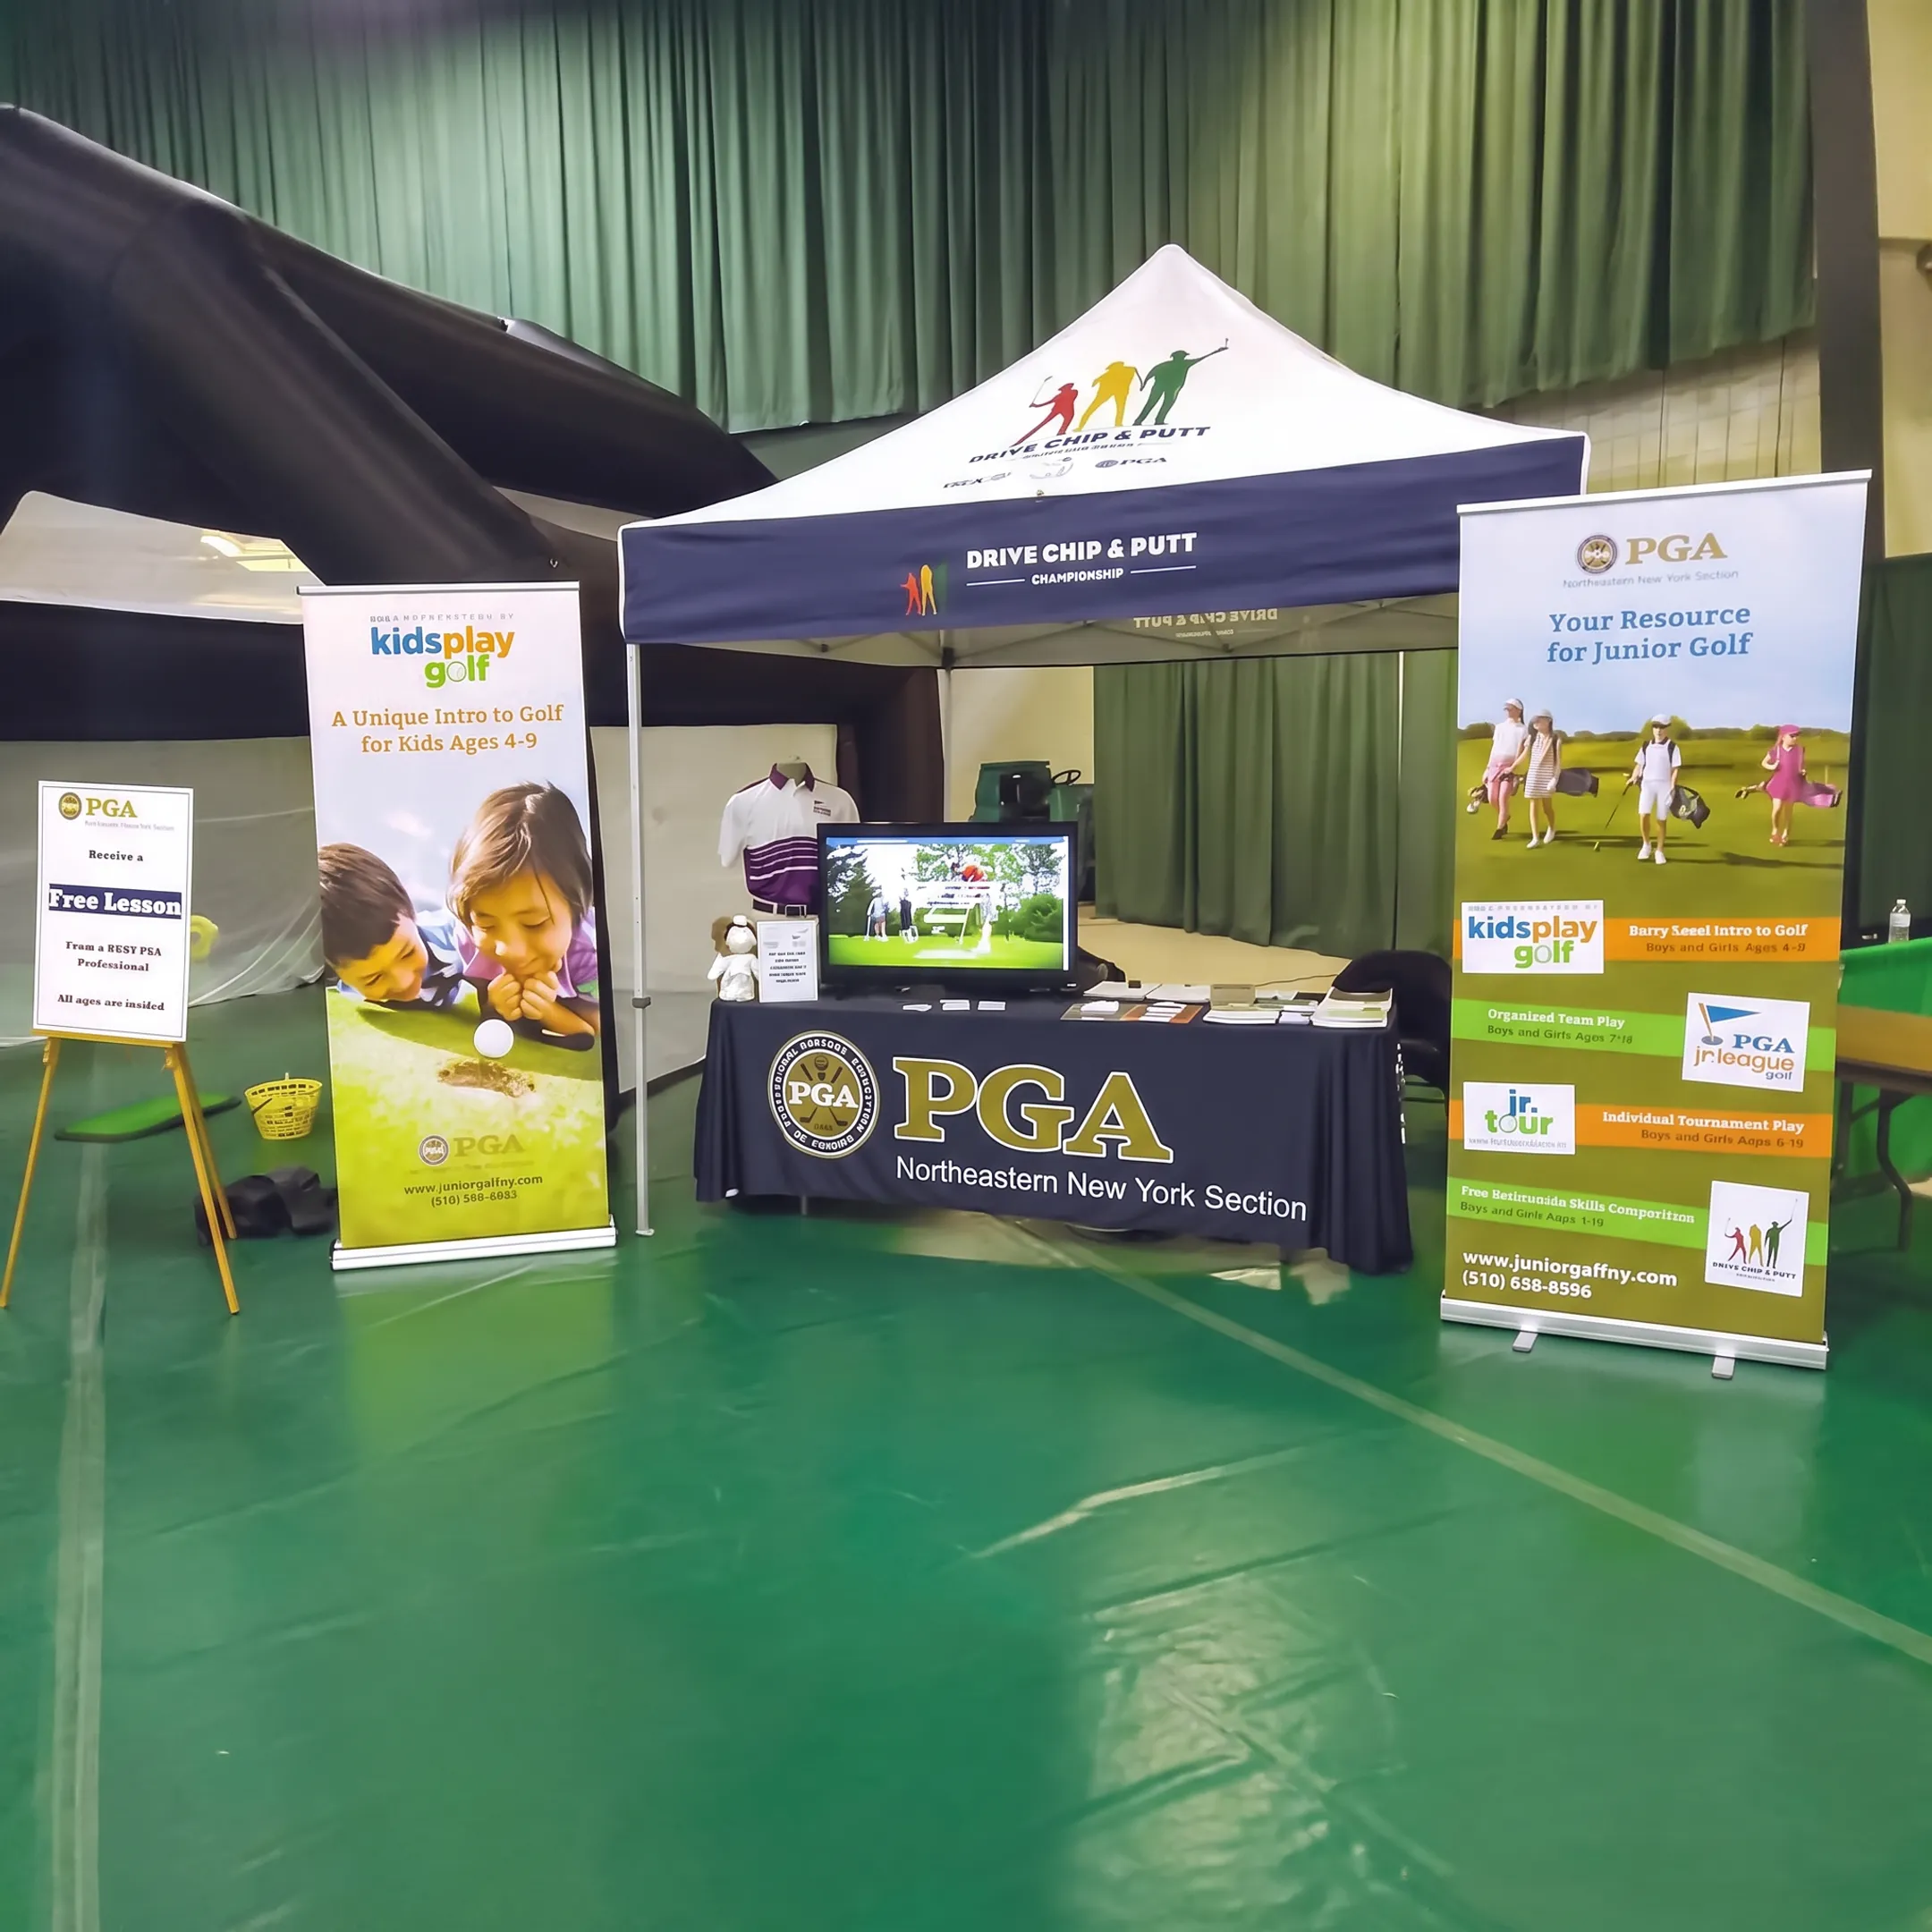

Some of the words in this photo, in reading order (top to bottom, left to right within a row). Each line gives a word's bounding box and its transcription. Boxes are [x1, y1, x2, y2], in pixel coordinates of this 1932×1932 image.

[969, 444, 1038, 463] DRIVE
[1044, 432, 1108, 449] CHIP
[1114, 430, 1131, 441] &
[1139, 427, 1211, 439] PUTT
[1119, 457, 1167, 465] PGA
[966, 545, 1038, 569] DRIVE
[1042, 540, 1102, 564] CHIP
[1106, 538, 1124, 559] &
[1131, 532, 1198, 557] PUTT
[1625, 532, 1728, 565] PGA
[1031, 568, 1123, 585] CHAMPIONSHIP
[1666, 572, 1691, 582] York
[1549, 614, 1614, 632] Your
[1620, 607, 1750, 630] Resource
[370, 625, 515, 659] kidsplay
[1546, 641, 1588, 663] for
[1592, 637, 1682, 665] Junior
[1690, 631, 1753, 657] Golf
[424, 654, 490, 689] golf
[332, 711, 347, 726] A
[352, 709, 428, 731] Unique
[435, 708, 487, 725] Intro
[494, 708, 513, 724] to
[520, 705, 564, 722] Golf
[361, 735, 393, 753] for
[398, 734, 444, 752] Kids
[449, 734, 499, 756] Ages
[504, 733, 538, 750] 4-9
[85, 797, 138, 818] PGA
[89, 850, 133, 861] Receive
[137, 853, 143, 861] a
[49, 888, 98, 911] Free
[104, 892, 182, 916] Lesson
[1468, 915, 1597, 944] kidsplay
[1714, 925, 1752, 936] Intro
[1756, 926, 1771, 936] to
[1775, 924, 1809, 936] Golf
[1513, 939, 1574, 969] golf
[1647, 943, 1675, 953] Boys
[1680, 943, 1704, 953] and
[1708, 943, 1739, 953] Girls
[78, 959, 149, 972] Professional
[57, 995, 73, 1004] All
[76, 997, 101, 1006] ages
[105, 999, 123, 1008] are
[1558, 1013, 1593, 1026] Team
[1597, 1016, 1625, 1030] Play
[1518, 1029, 1540, 1038] and
[1732, 1033, 1795, 1054] PGA
[788, 1080, 859, 1109] PGA
[893, 1056, 1174, 1164] PGA
[1485, 1110, 1554, 1135] tour
[1603, 1112, 1674, 1125] Individual
[1677, 1114, 1769, 1131] Tournament
[1772, 1120, 1804, 1134] Play
[453, 1134, 526, 1157] PGA
[1675, 1132, 1699, 1142] and
[895, 1156, 1059, 1194] Northeastern
[1067, 1171, 1127, 1200] New
[1134, 1177, 1196, 1208] York
[1204, 1184, 1307, 1221] Section
[1462, 1185, 1489, 1199] Free
[1570, 1199, 1605, 1213] Skills
[1491, 1208, 1513, 1218] and
[1581, 1216, 1604, 1228] 1-19
[1462, 1270, 1505, 1290] (510)
[1463, 1252, 1678, 1287] www.juniorgaffny.com
[1773, 1271, 1796, 1279] PUTT
